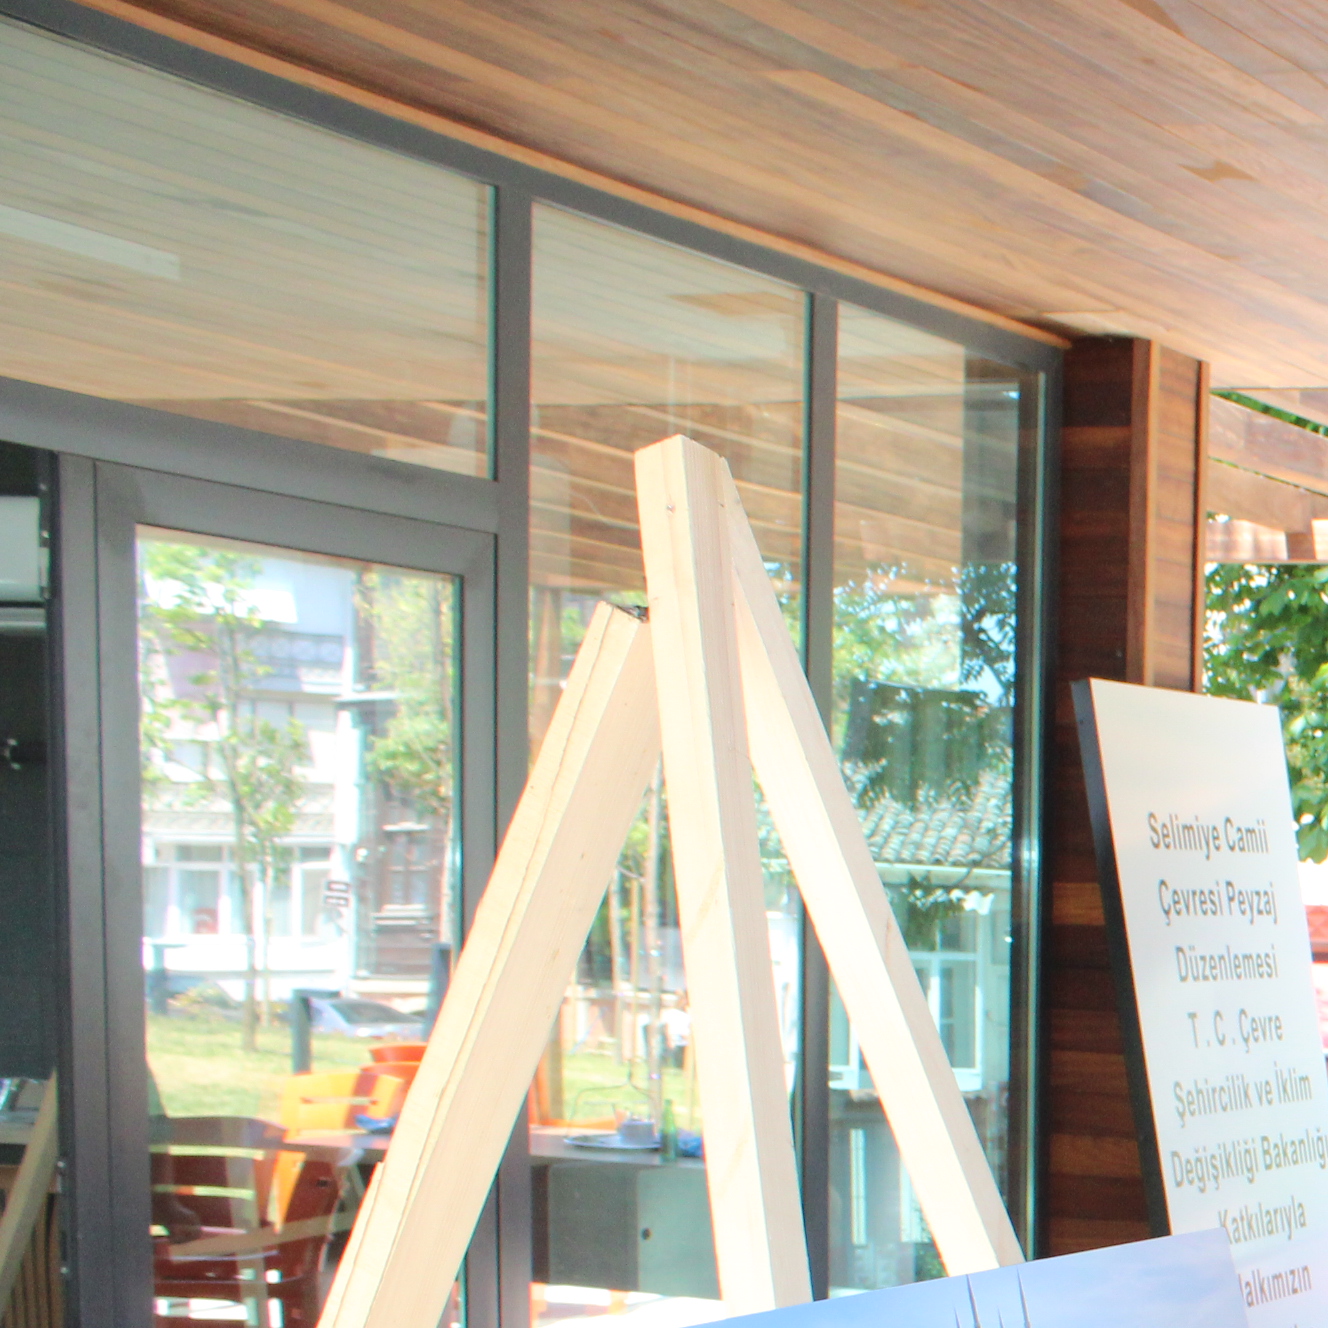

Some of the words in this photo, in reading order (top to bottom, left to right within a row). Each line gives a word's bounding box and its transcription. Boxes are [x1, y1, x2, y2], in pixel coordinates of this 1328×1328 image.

[1147, 811, 1221, 861] Selimiye
[1224, 816, 1269, 854] Camii
[1158, 879, 1224, 926] Çevresi
[1225, 880, 1278, 925] Peyzaj
[1175, 944, 1279, 982] Düzenlemesi
[1238, 1008, 1284, 1053] Çevre
[1173, 1073, 1253, 1128] Şehircilik
[1254, 1079, 1274, 1107] ve
[1273, 1060, 1313, 1104] İklim
[1170, 1137, 1260, 1193] Değişikliği
